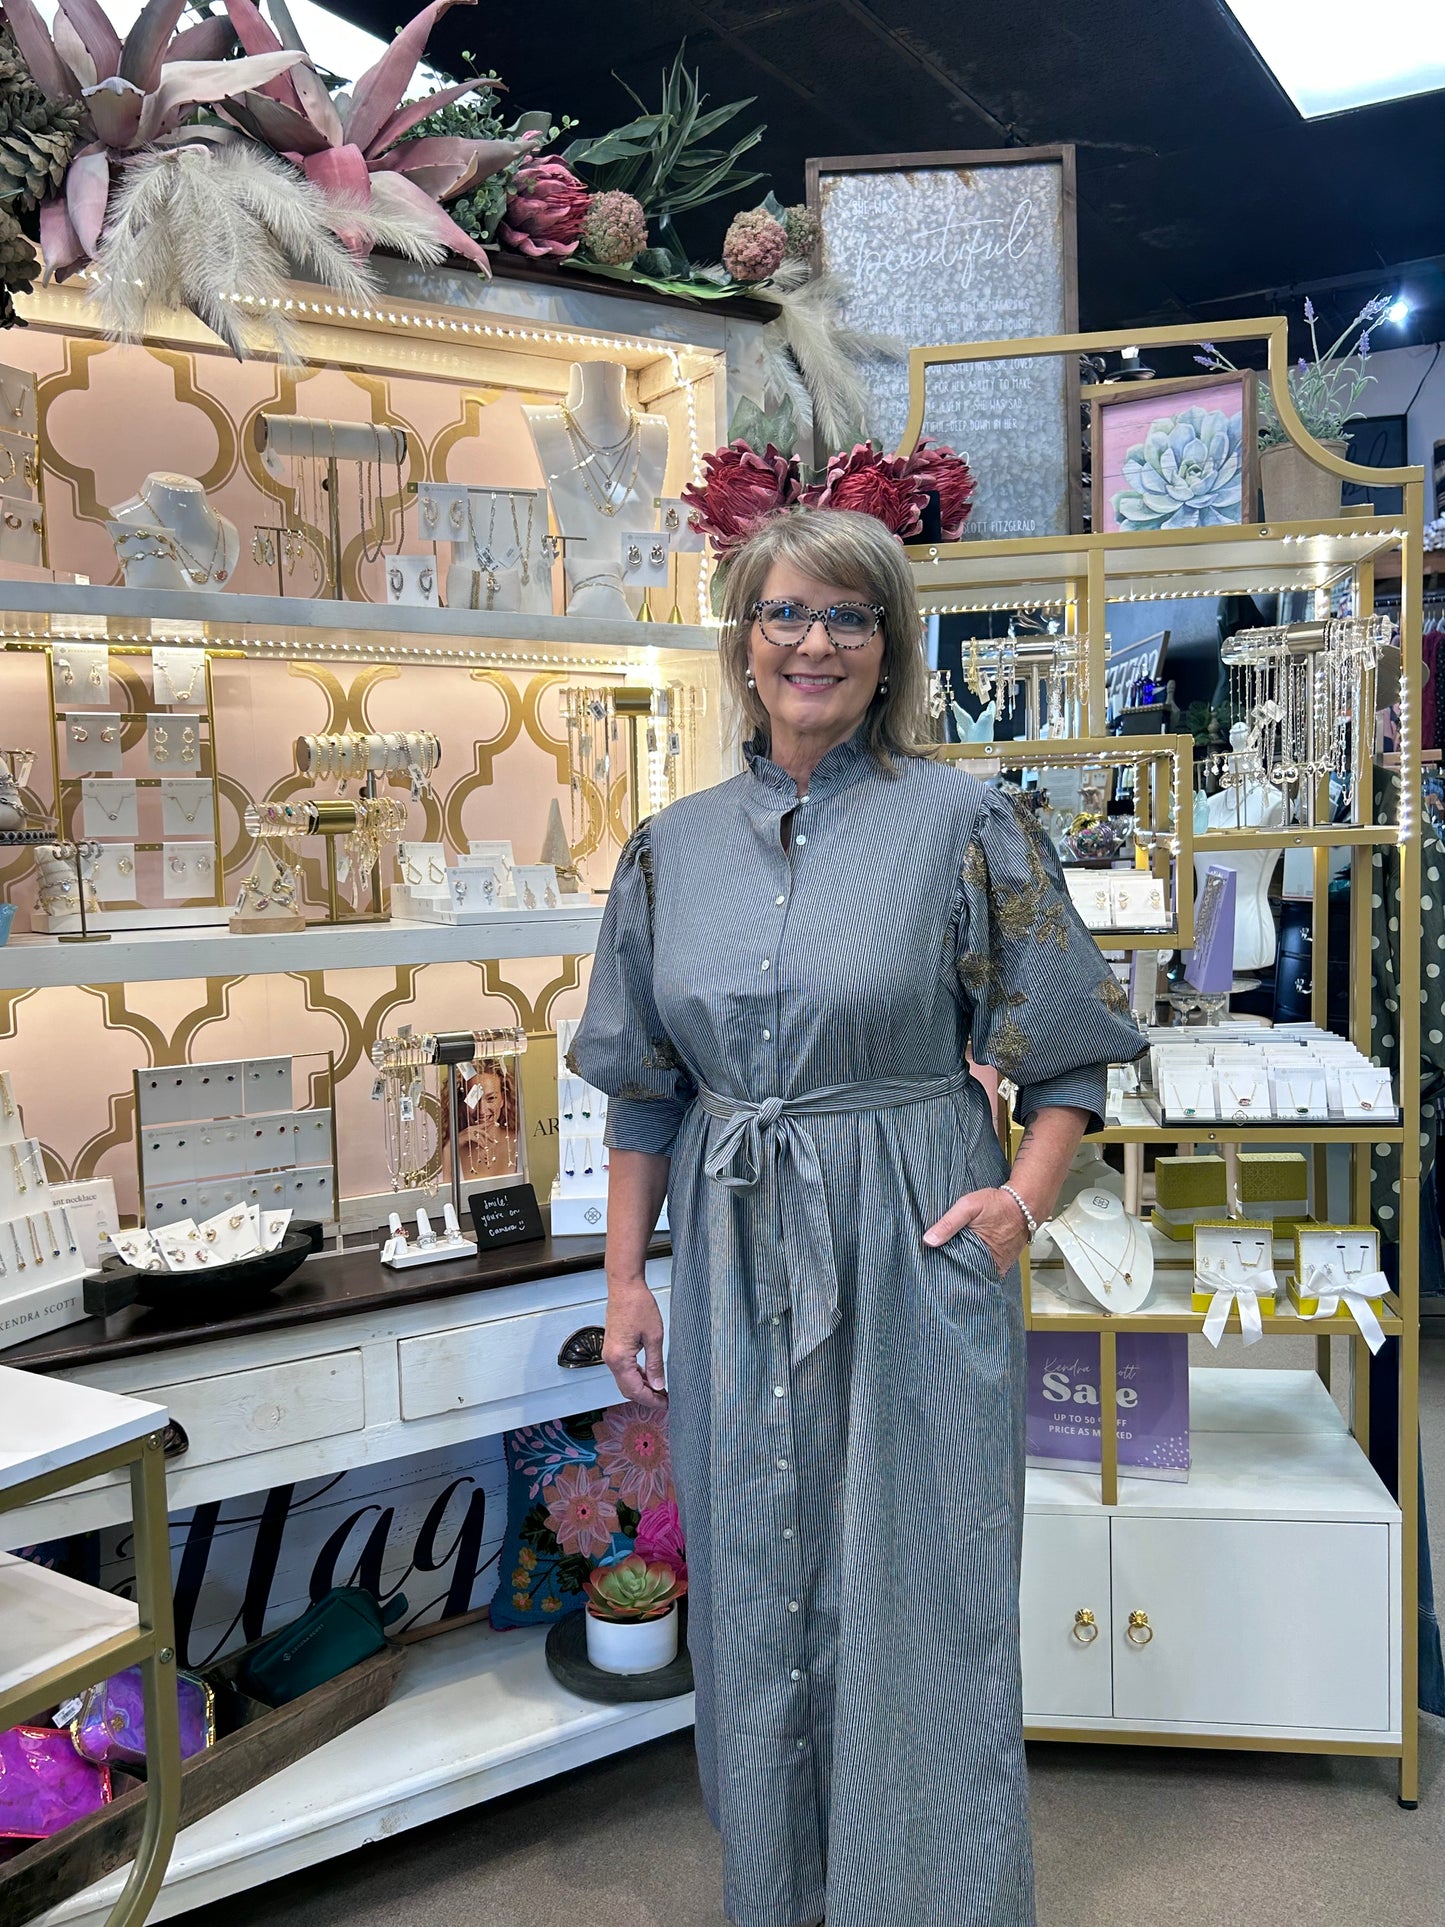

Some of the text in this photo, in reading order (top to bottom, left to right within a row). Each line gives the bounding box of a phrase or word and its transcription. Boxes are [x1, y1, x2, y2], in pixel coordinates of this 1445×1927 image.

[856, 199, 1032, 289] beautiful
[992, 520, 1035, 532] FITZGERALD
[533, 1117, 559, 1137] AR
[65, 1194, 97, 1205] necklace
[483, 1195, 508, 1210] Smile!
[509, 1209, 520, 1217] on
[0, 1297, 77, 1331] KENDRA SCOTT
[1043, 1357, 1092, 1377] Kendra
[1042, 1372, 1138, 1408] Sae
[1053, 1413, 1067, 1421] UP
[1069, 1415, 1082, 1423] TO
[1085, 1416, 1096, 1424] 50
[1048, 1425, 1133, 1440] PRICE AS MKED
